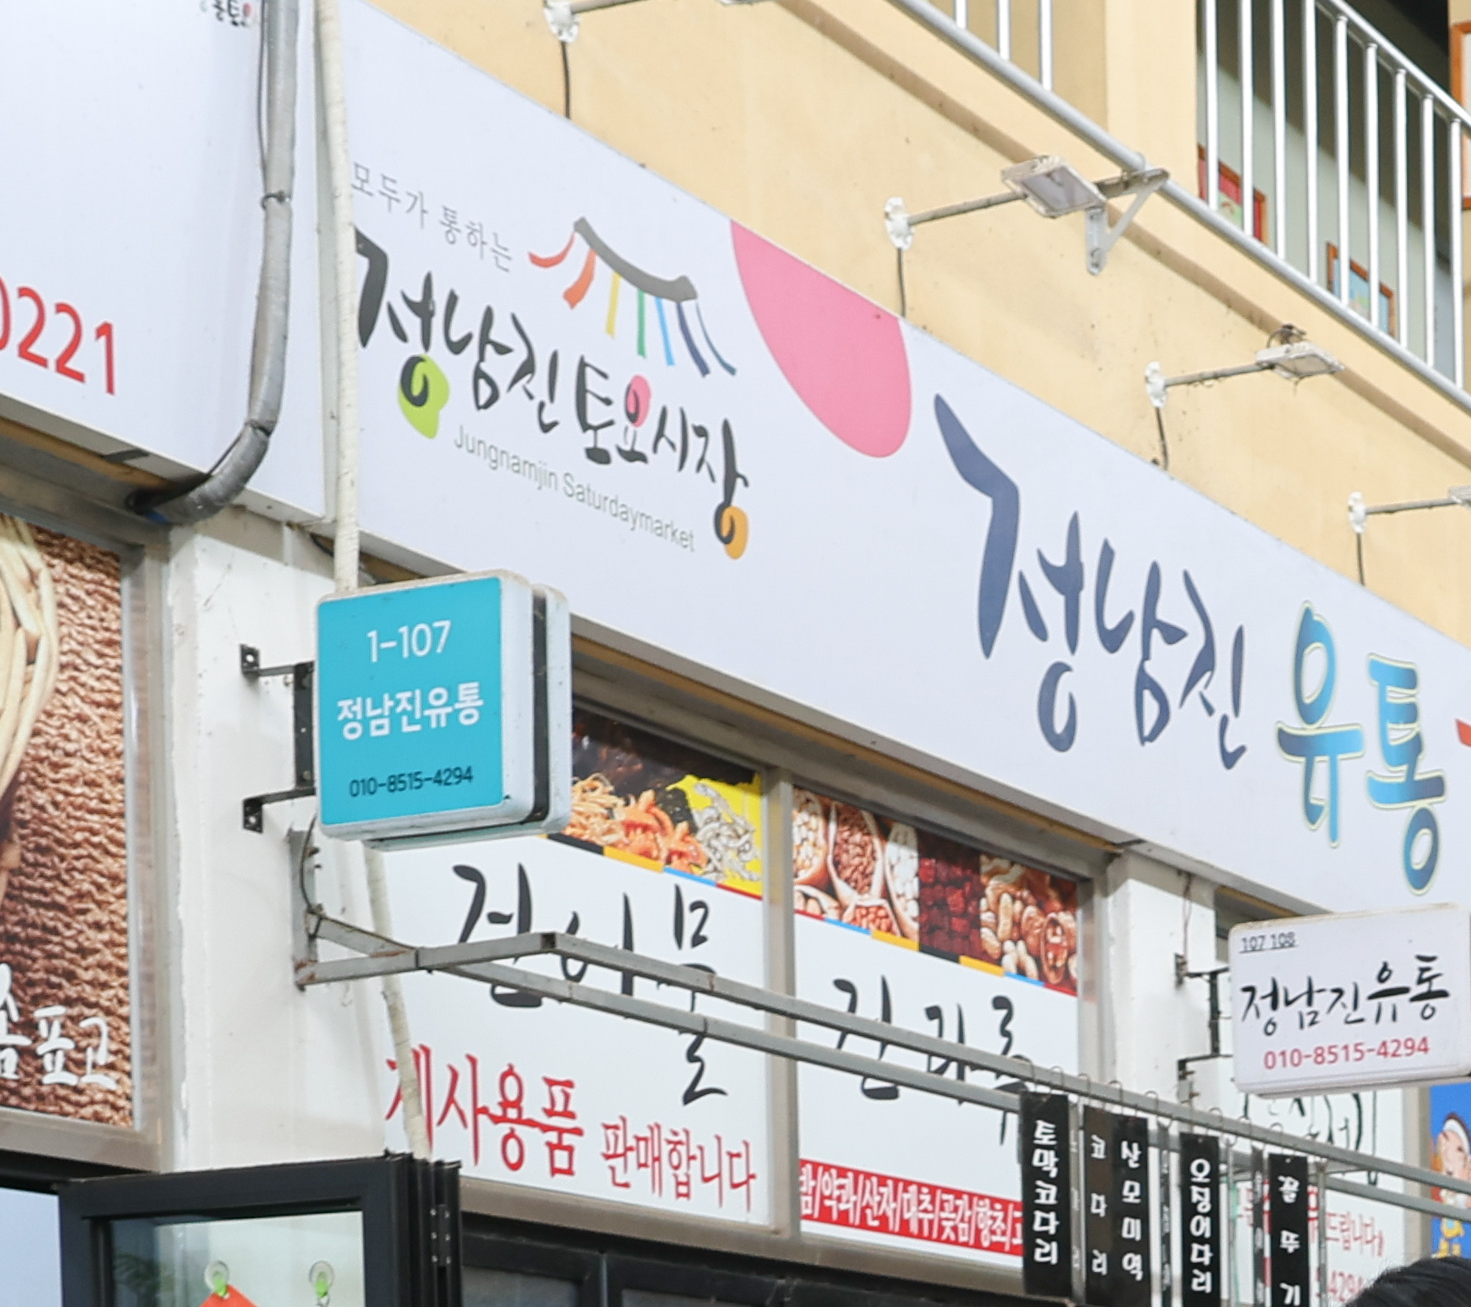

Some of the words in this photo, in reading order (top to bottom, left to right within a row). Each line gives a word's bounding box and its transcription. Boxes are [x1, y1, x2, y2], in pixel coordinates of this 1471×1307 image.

[352, 162, 427, 230] 모두가
[439, 206, 513, 273] 통하는
[454, 424, 560, 492] Jungnamjin
[562, 471, 696, 553] Saturdaymarket
[366, 620, 452, 663] 1-107
[934, 393, 1247, 771] 정남진
[1276, 600, 1447, 896] 유통
[337, 682, 484, 740] 정남진유통
[349, 766, 473, 797] 010-8515-4294
[1240, 934, 1266, 953] 107
[1270, 931, 1296, 951] 108
[1241, 954, 1449, 1038] 정남진유통
[1263, 1036, 1431, 1071] 010-8515-4294
[601, 1115, 759, 1213] 판매합니다
[1032, 1120, 1060, 1265] 토막코다리
[1091, 1134, 1108, 1276] 코다리
[1189, 1158, 1214, 1294] 오징어다리
